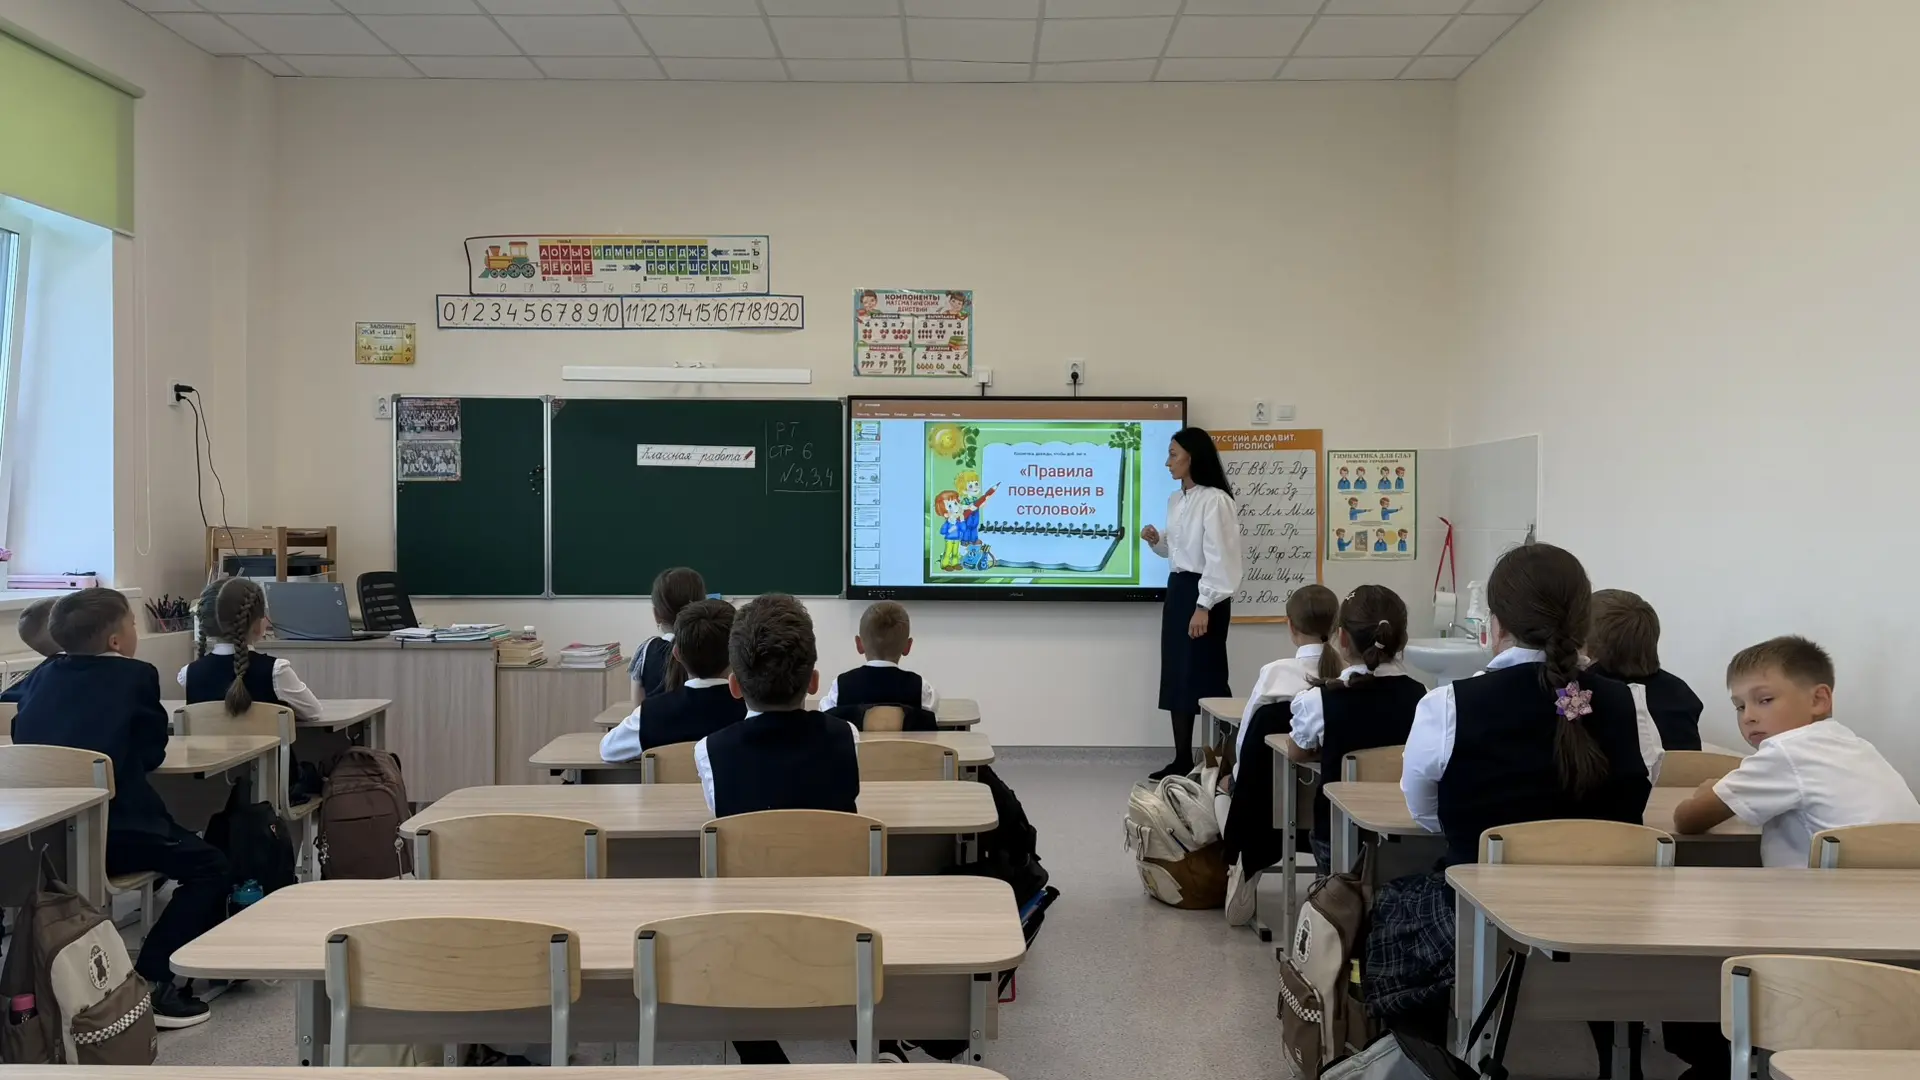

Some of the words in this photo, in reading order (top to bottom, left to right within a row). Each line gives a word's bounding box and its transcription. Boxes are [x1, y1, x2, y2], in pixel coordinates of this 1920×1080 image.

[443, 302, 456, 322] 0
[460, 302, 469, 322] 1
[472, 302, 485, 322] 2
[490, 302, 501, 322] 3
[506, 302, 518, 322] 4
[524, 302, 536, 322] 5
[540, 302, 553, 322] 6
[556, 302, 568, 322] 7
[571, 302, 583, 322] 8
[588, 302, 599, 322] 9
[602, 302, 619, 322] 10
[624, 302, 640, 322] 11
[640, 302, 656, 322] 12
[660, 302, 675, 322] 13
[676, 302, 692, 322] 14
[695, 302, 712, 322] 15
[712, 302, 728, 322] 16
[730, 302, 746, 322] 17
[747, 302, 762, 322] 18
[764, 302, 779, 322] 19
[779, 302, 800, 322] 20
[802, 442, 814, 460] 6
[1232, 442, 1274, 450] ПРОПИСИ
[640, 446, 692, 460] Классная
[698, 448, 742, 465] работа
[1020, 464, 1094, 480] «Правила
[1008, 486, 1091, 498] поведения
[1096, 486, 1104, 496] в
[1246, 482, 1280, 496] Жж
[1016, 502, 1096, 515] столовой»
